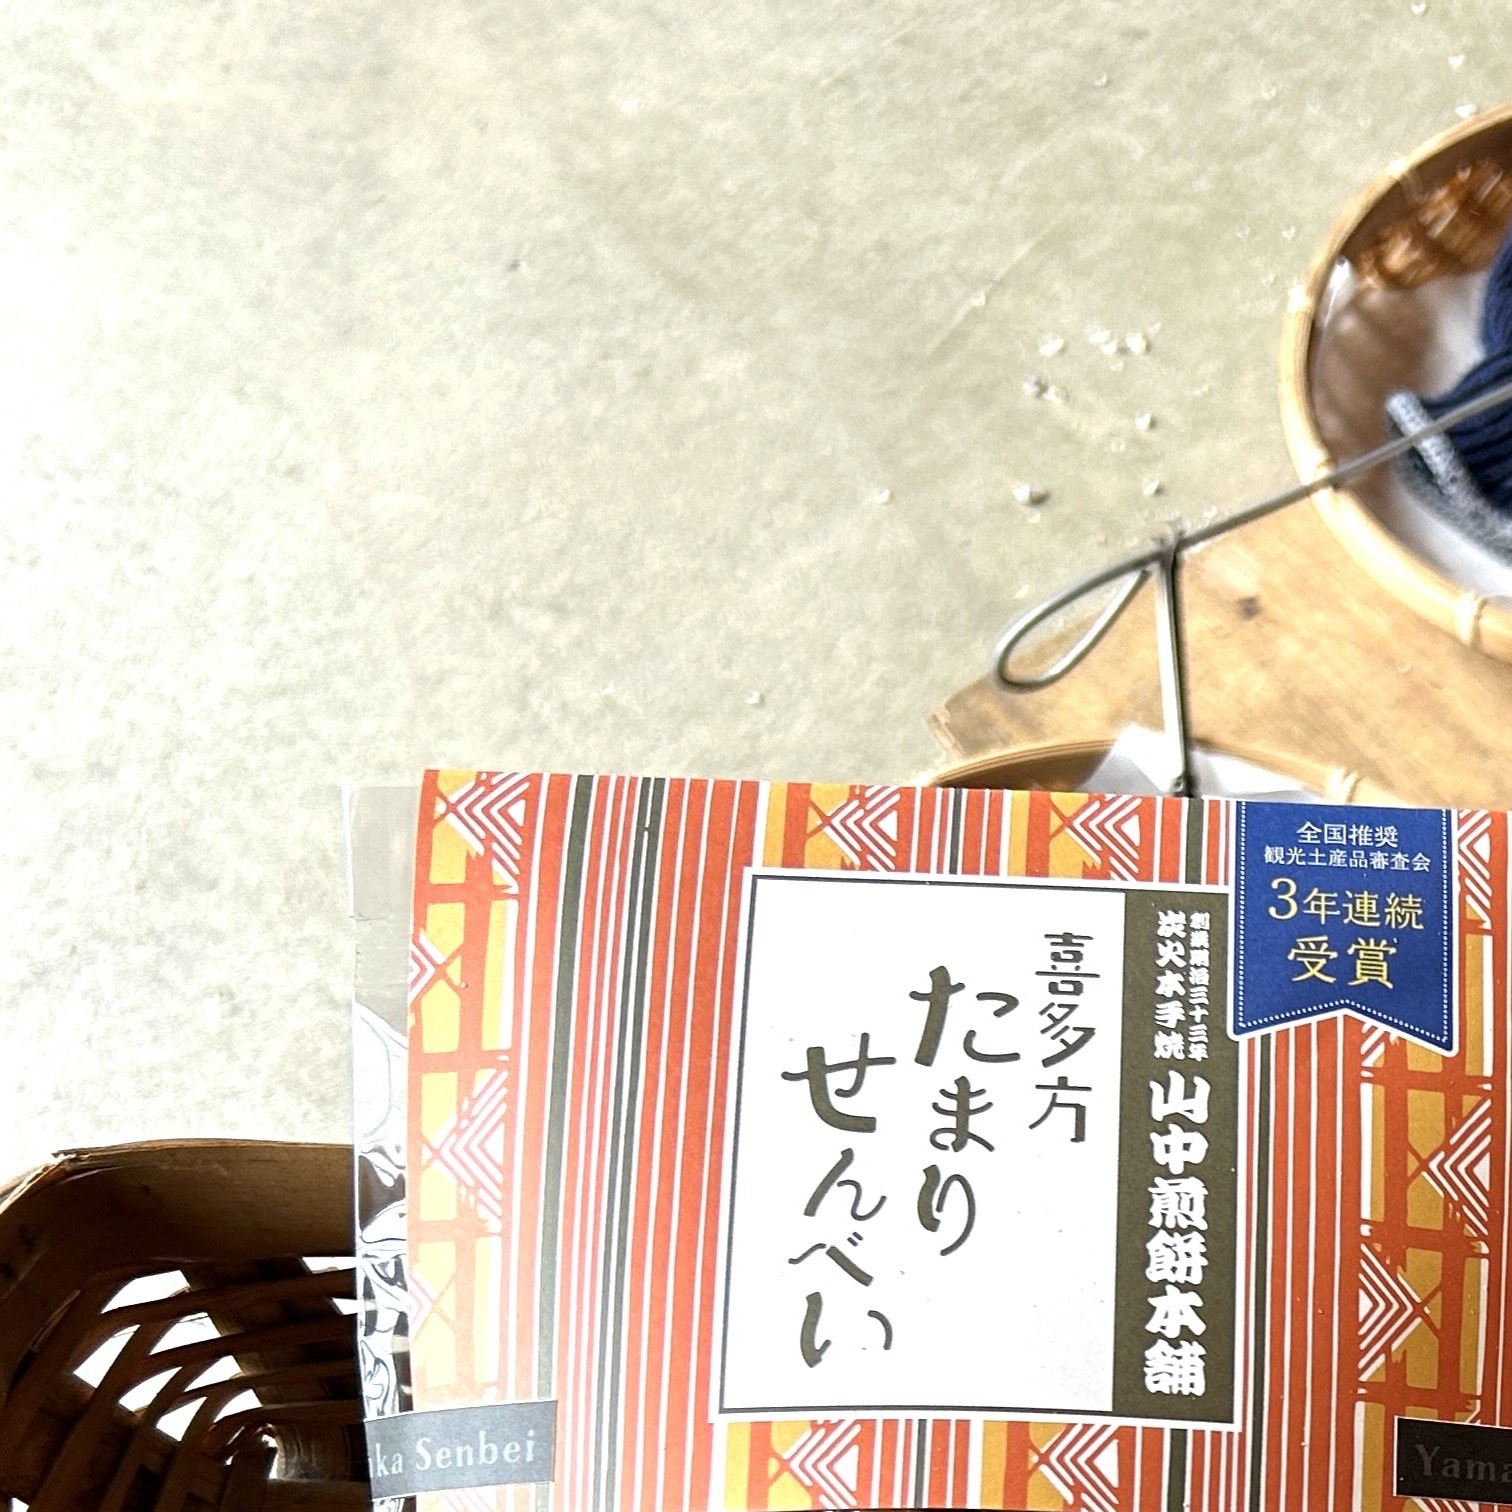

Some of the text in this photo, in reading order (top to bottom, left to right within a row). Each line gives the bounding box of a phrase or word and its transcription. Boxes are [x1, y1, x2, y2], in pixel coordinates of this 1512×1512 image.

[1264, 846, 1431, 873] 観光土産品審査会
[1296, 821, 1399, 848] 全国推奨
[1268, 877, 1425, 931] 3年連続
[1286, 934, 1398, 990] 受賞
[1027, 931, 1101, 1145] 喜多方
[908, 964, 1020, 1257] たまり
[780, 1031, 898, 1370] せんべい
[1143, 1069, 1213, 1398] 山中煎餅本舗
[414, 1429, 536, 1472] Senbei
